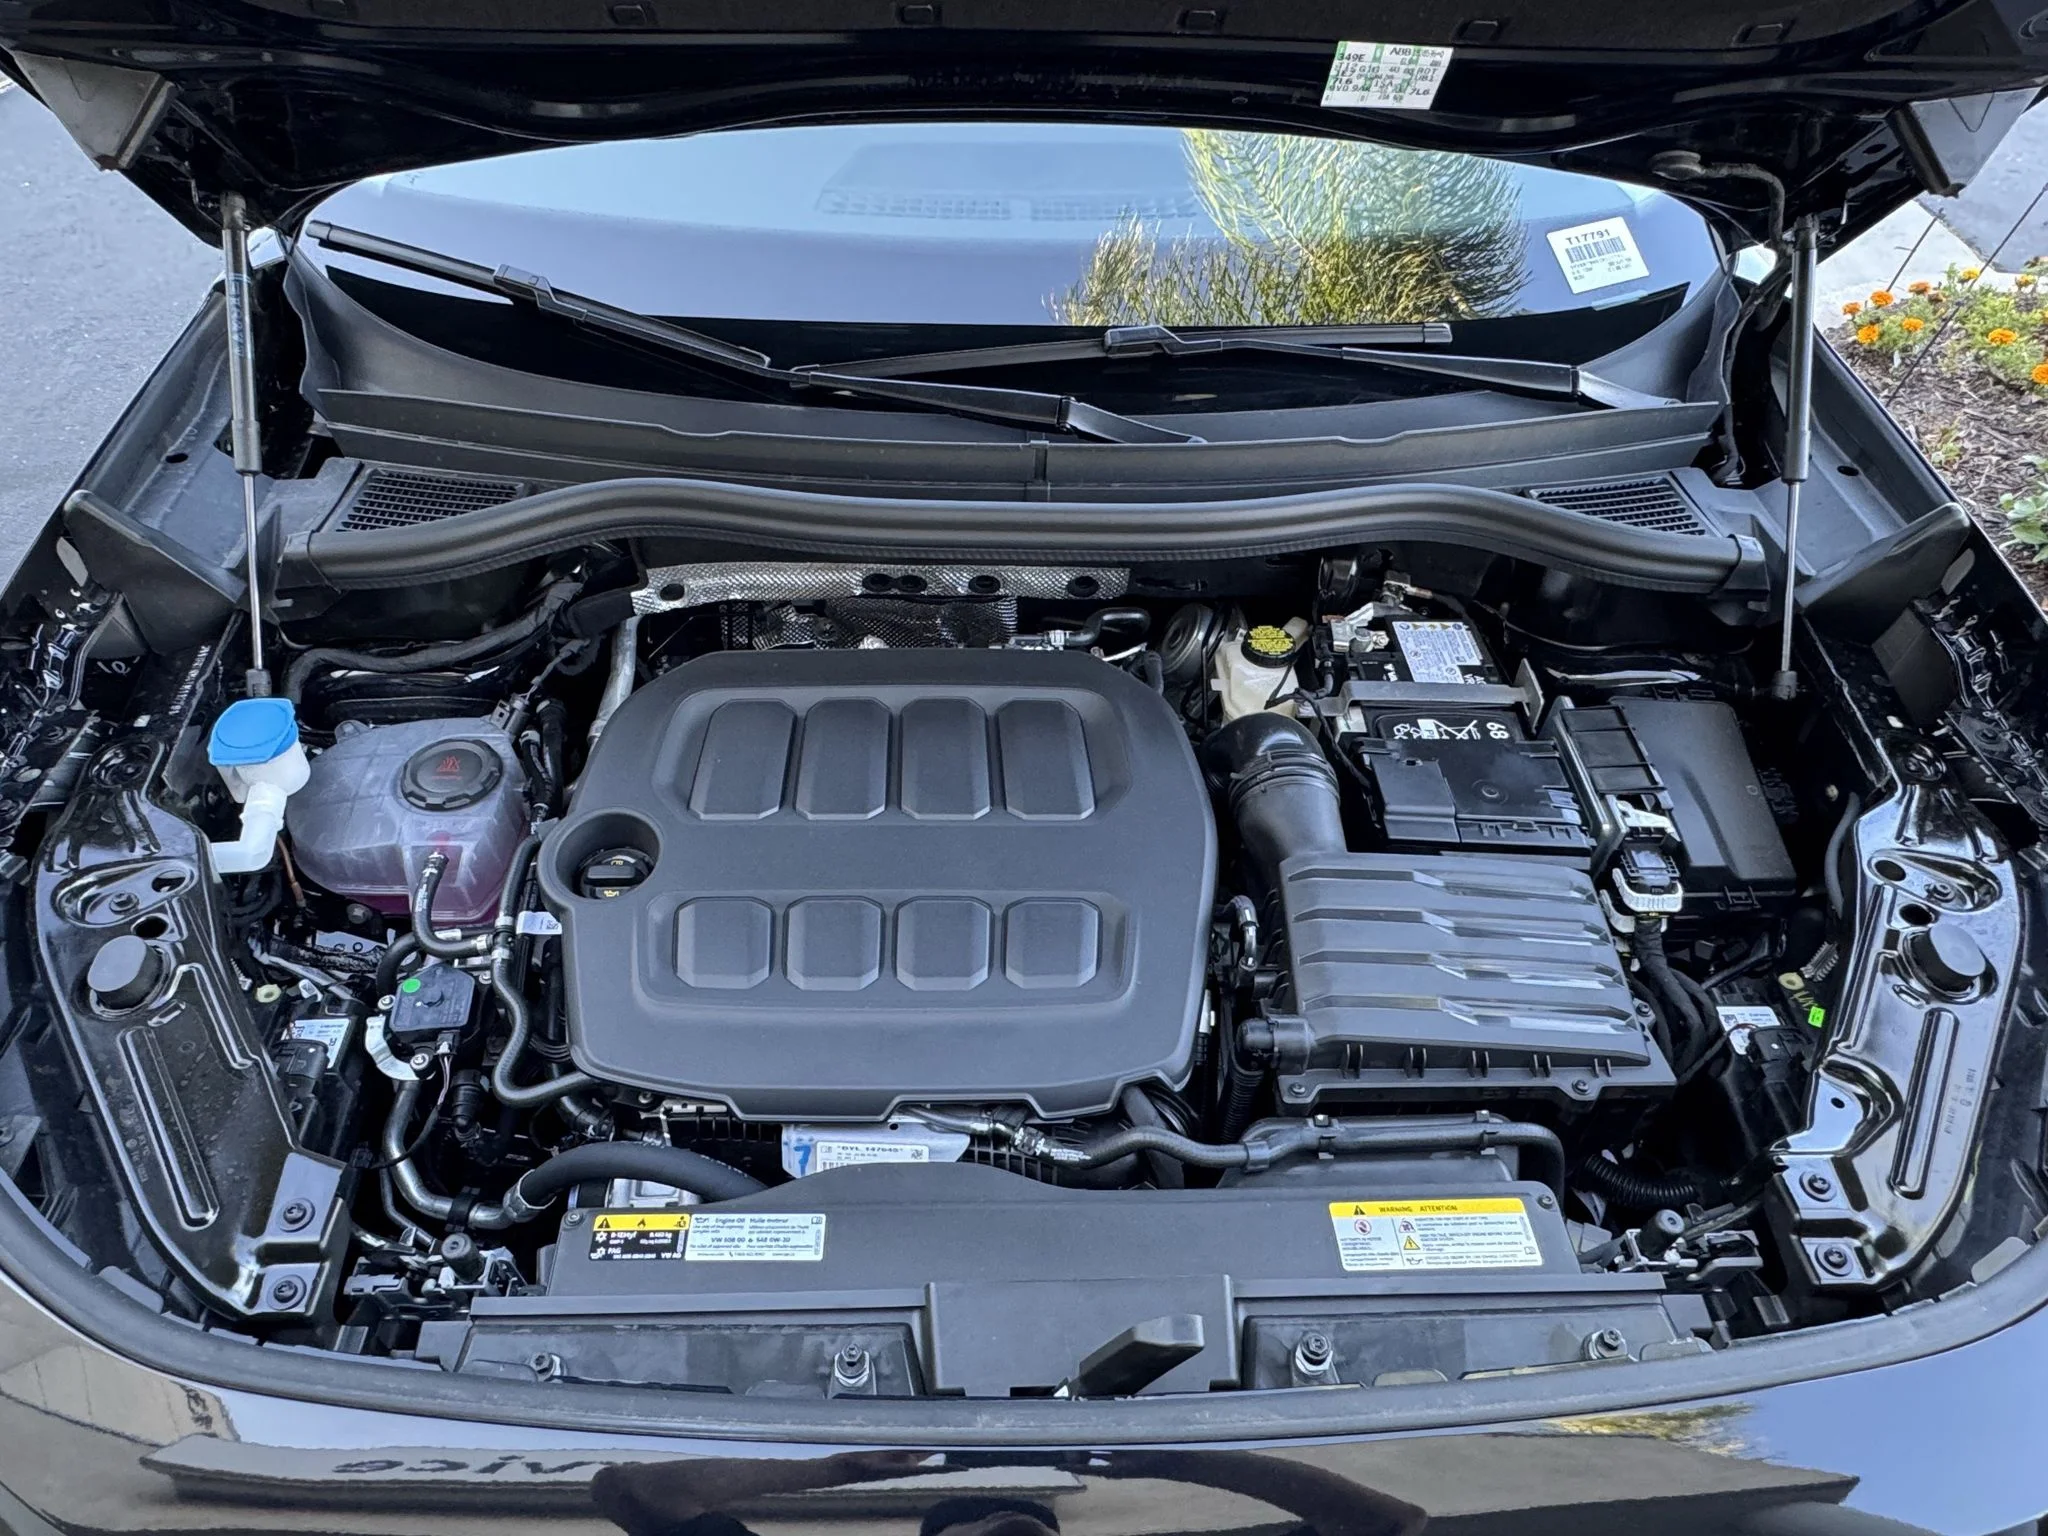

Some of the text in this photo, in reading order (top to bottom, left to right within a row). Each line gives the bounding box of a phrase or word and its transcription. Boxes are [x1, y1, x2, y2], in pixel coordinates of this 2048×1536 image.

[1565, 228, 1611, 245] T17791
[1420, 1204, 1458, 1212] ATTENTION
[715, 1217, 735, 1225] Engine
